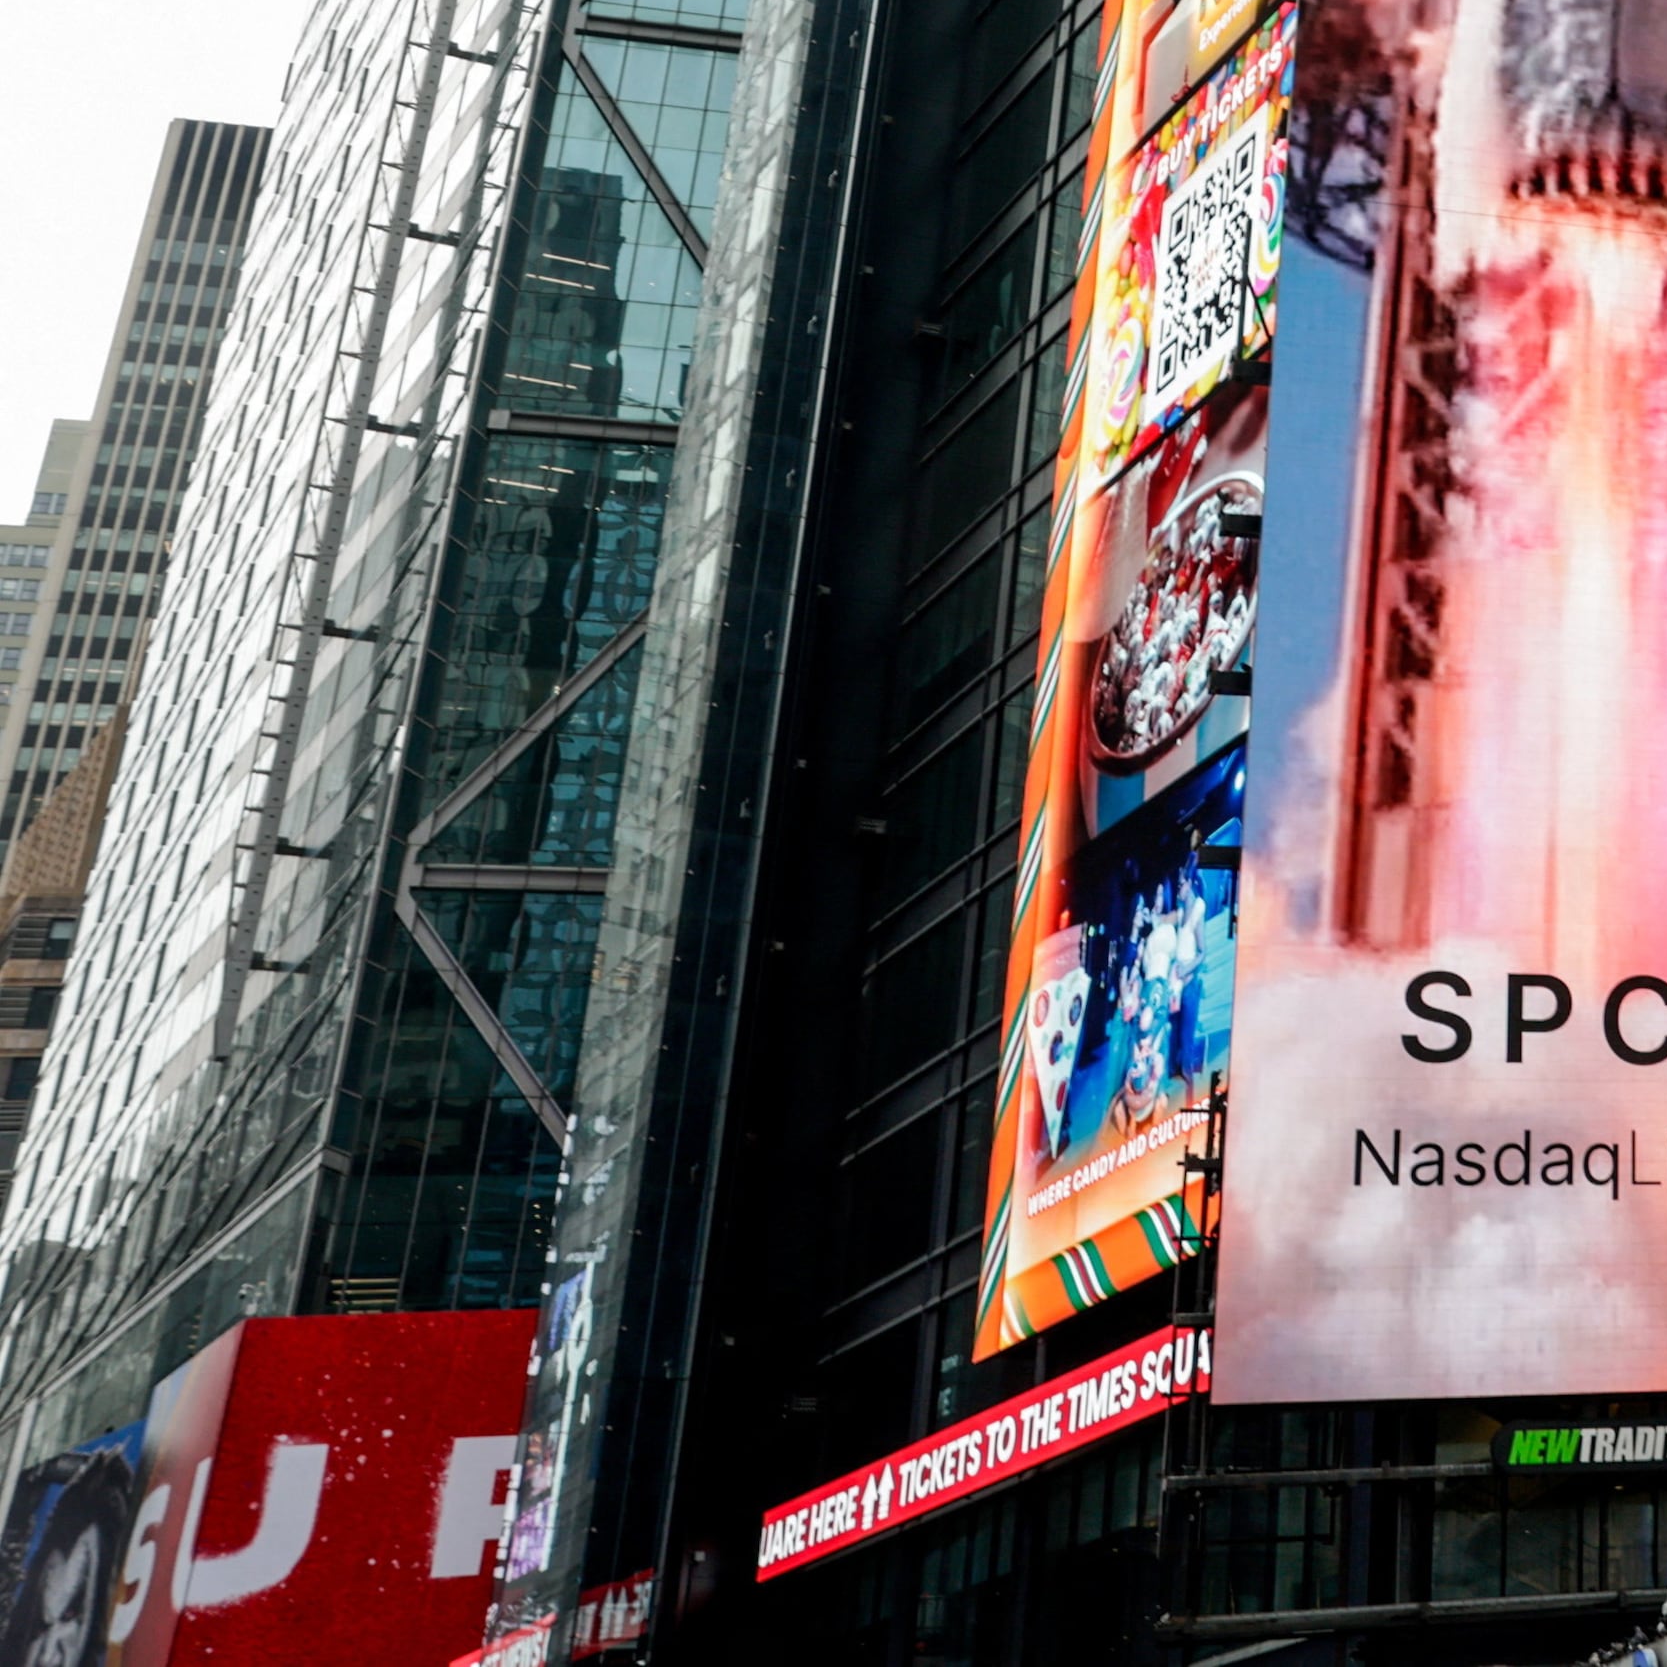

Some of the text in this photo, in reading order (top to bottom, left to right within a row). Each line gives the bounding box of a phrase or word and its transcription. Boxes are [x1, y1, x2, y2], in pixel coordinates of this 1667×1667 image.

[1156, 40, 1284, 186] BUY TICKETS
[1028, 1174, 1072, 1218] WHERE
[1072, 1149, 1117, 1192] CANDY
[1117, 1134, 1148, 1168] AND
[808, 1485, 860, 1547] HERE
[899, 1429, 983, 1507] TICKETS
[986, 1415, 1017, 1469] TO
[1020, 1392, 1065, 1454] THE
[1067, 1359, 1138, 1434] TIMES
